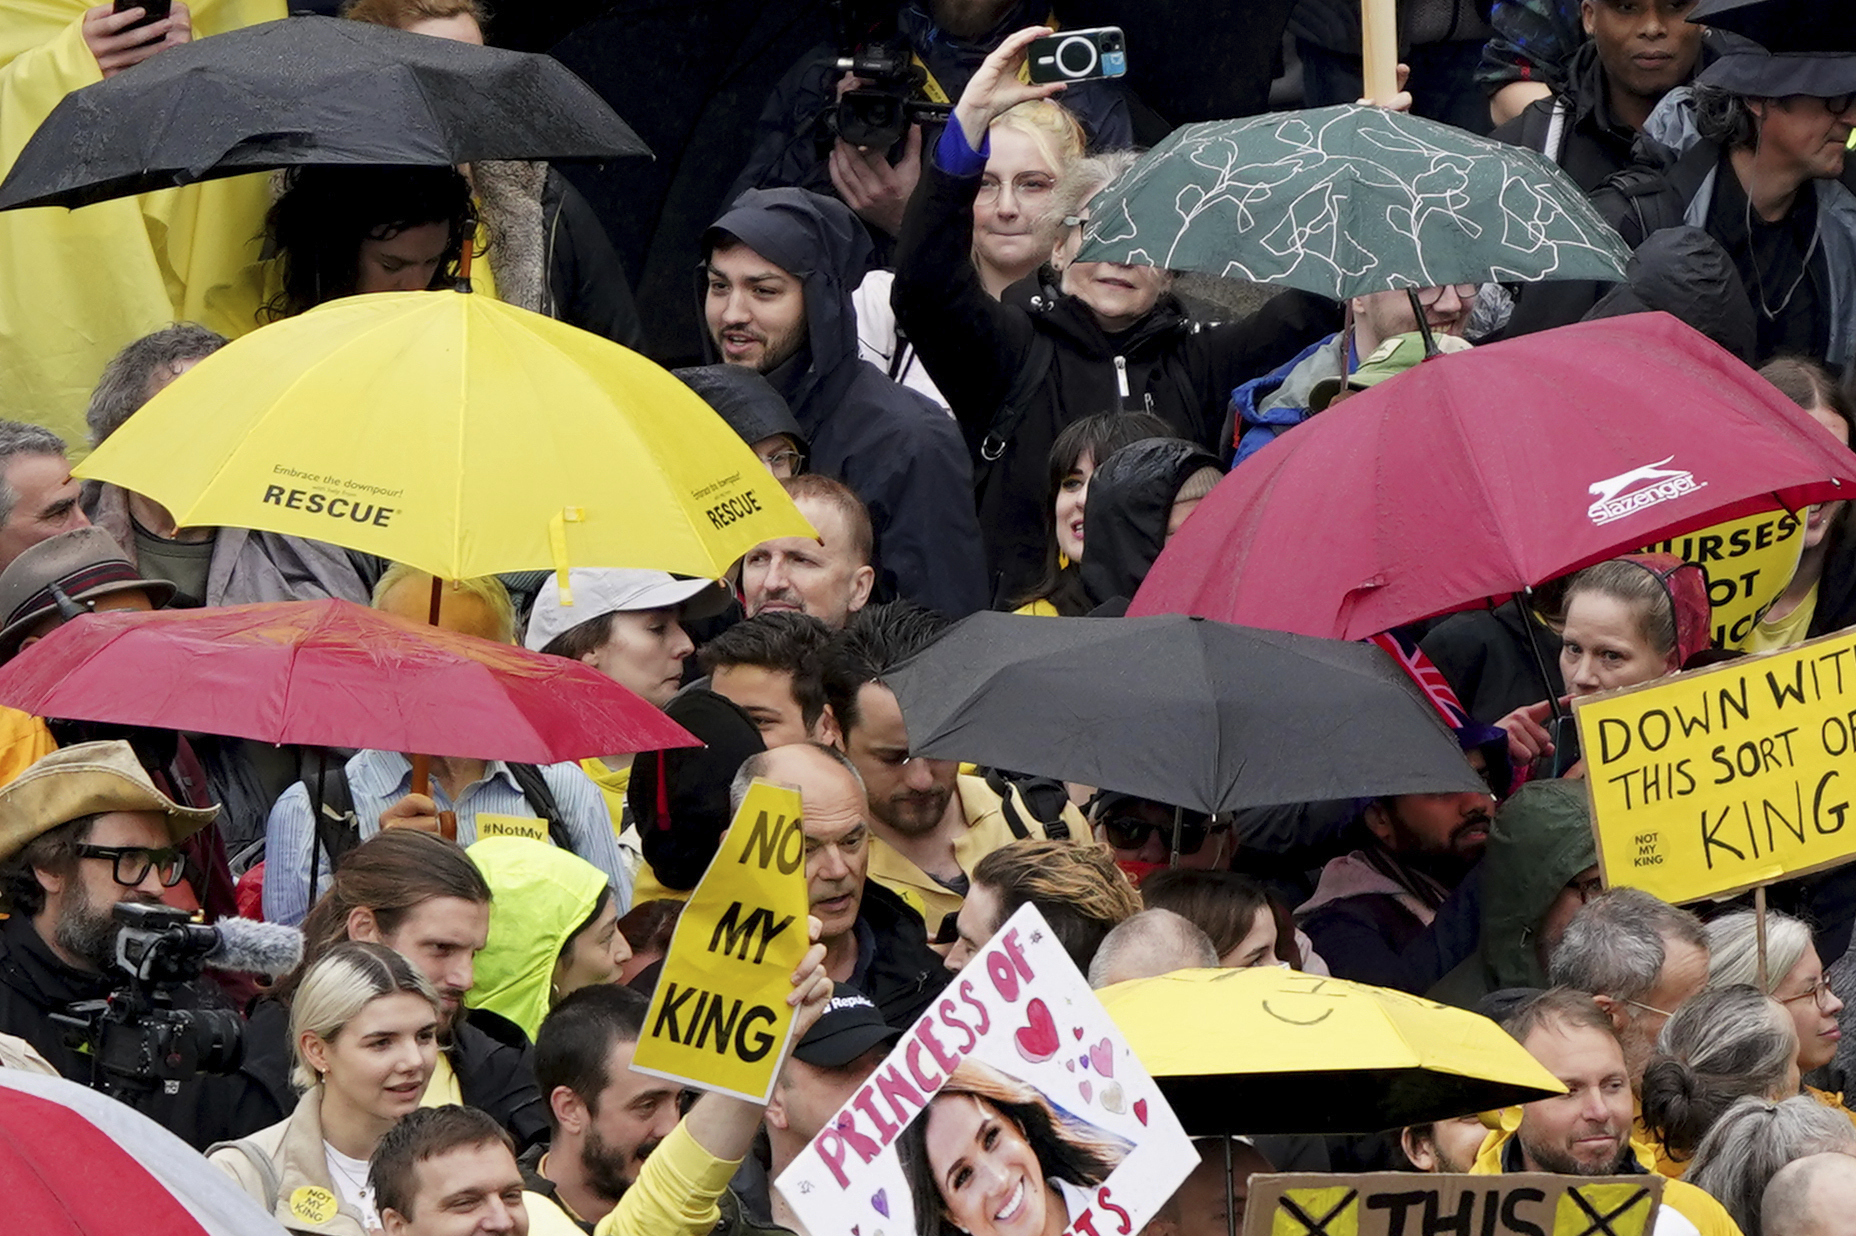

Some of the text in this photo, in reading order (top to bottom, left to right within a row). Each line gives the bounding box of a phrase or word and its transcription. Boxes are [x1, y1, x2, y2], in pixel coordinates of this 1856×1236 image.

[273, 464, 404, 498] Embrace the downpour!
[1588, 473, 1697, 523] Slazenger
[263, 484, 394, 527] RESCUE
[706, 490, 762, 530] RESCUE
[1707, 570, 1761, 607] OT
[1598, 675, 1749, 765] DOWN
[1608, 756, 1696, 810] THIS
[1712, 728, 1798, 786] SORT
[1635, 832, 1658, 845] NOT
[1700, 770, 1850, 869] KING
[1633, 854, 1663, 867] KING
[1639, 844, 1656, 855] MY
[708, 902, 796, 966] MY
[652, 982, 777, 1063] KING
[812, 926, 1037, 1191] PRINCESS OF
[295, 1203, 323, 1221] KING
[305, 1197, 325, 1210] MY
[307, 1189, 332, 1203] NOT
